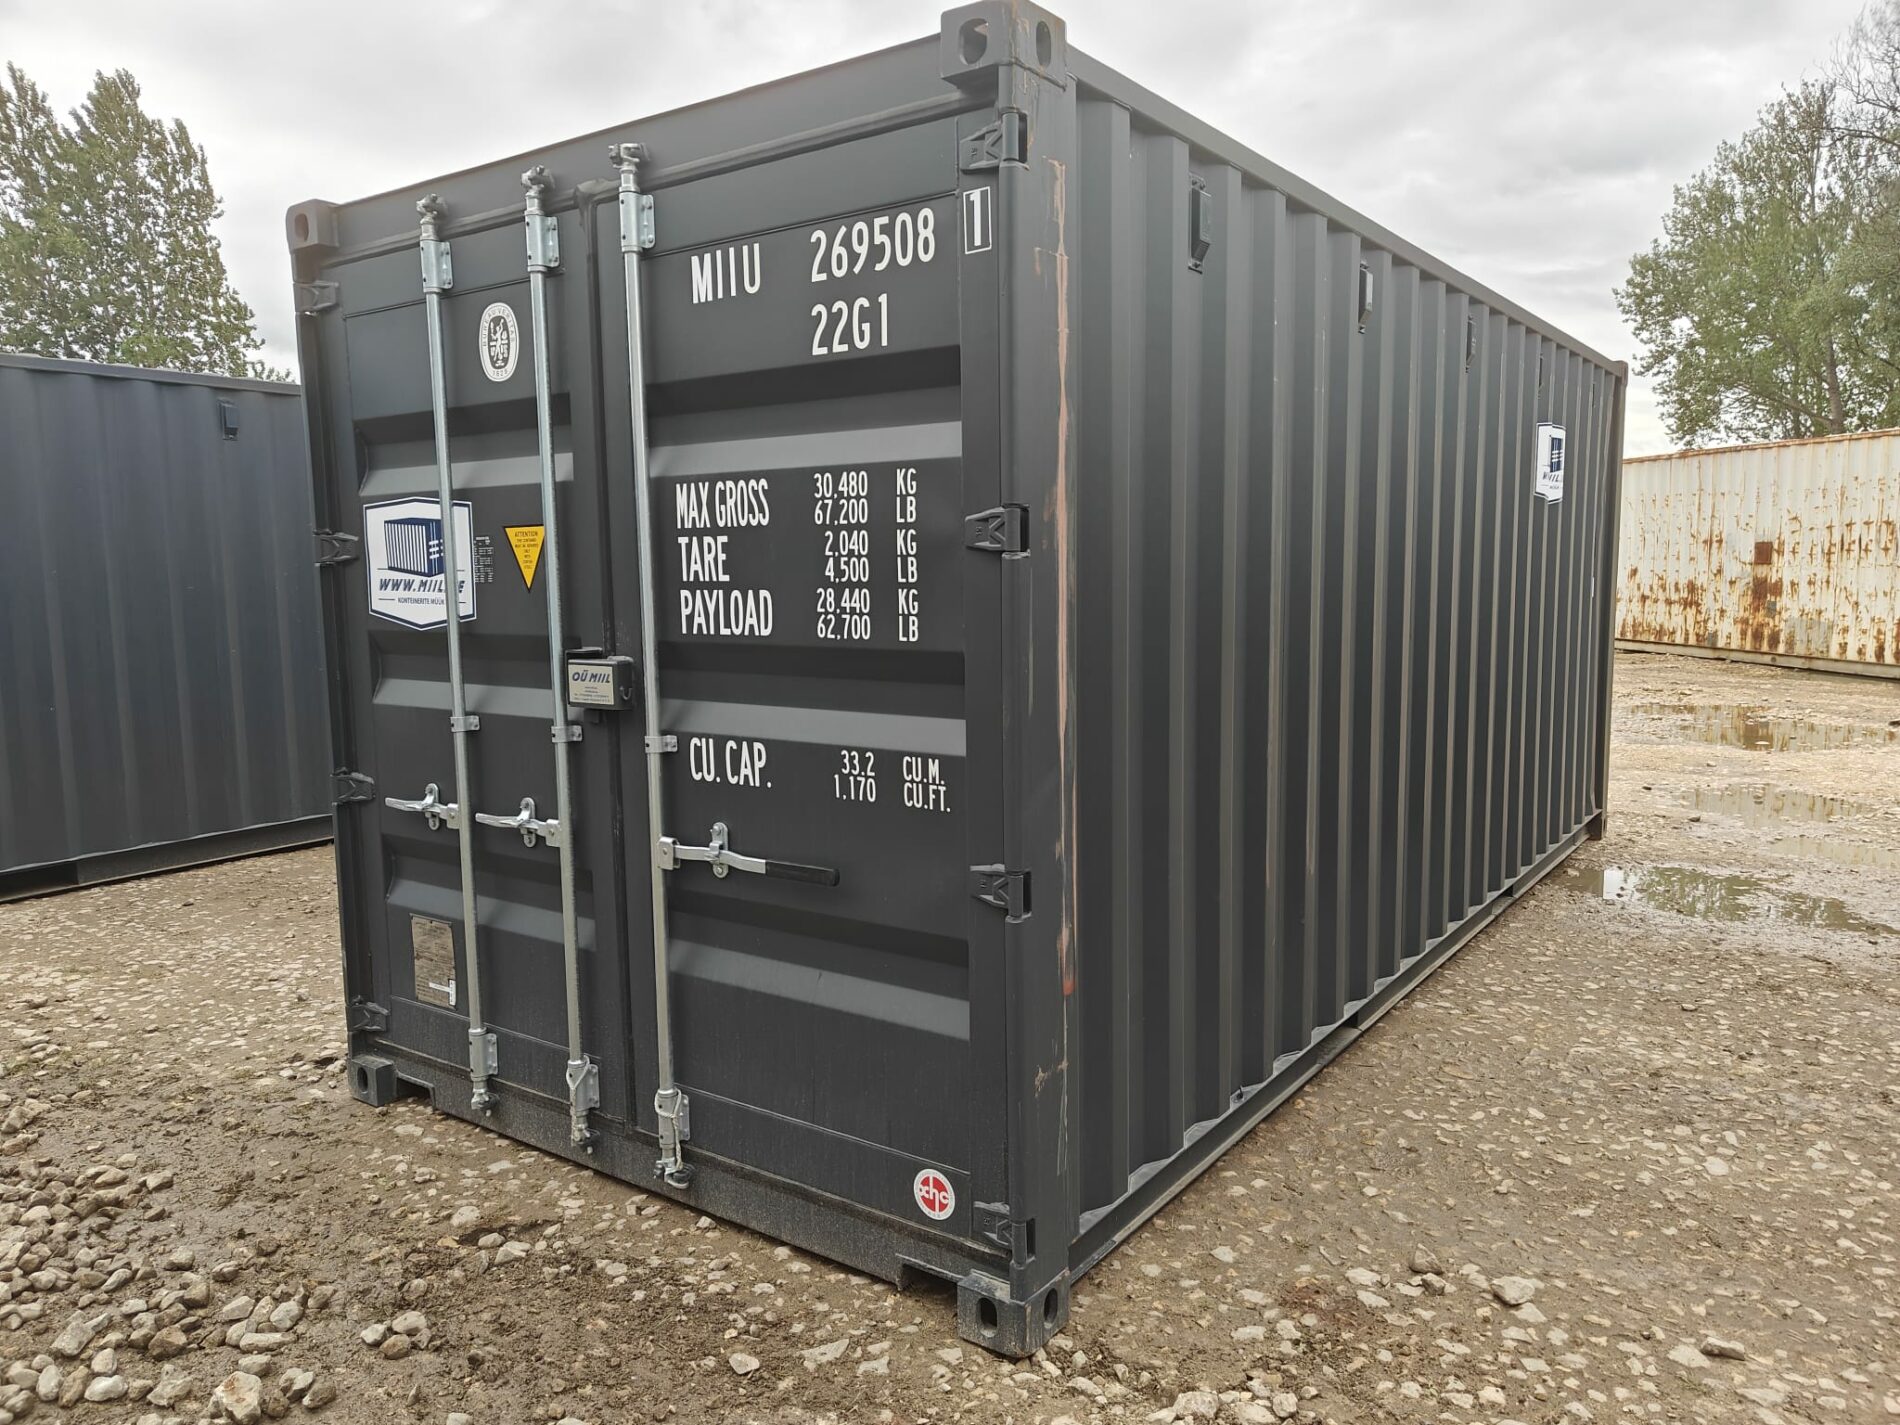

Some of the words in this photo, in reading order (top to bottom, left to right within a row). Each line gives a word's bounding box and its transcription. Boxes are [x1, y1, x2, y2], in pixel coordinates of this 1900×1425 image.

[691, 243, 760, 304] MIIU
[811, 208, 935, 282] 269508
[969, 189, 982, 247] 1
[812, 293, 888, 356] 22G1
[676, 482, 711, 529] MAX
[715, 478, 770, 527] GROSS
[813, 471, 868, 499] 30,480
[896, 468, 917, 496] KG
[814, 498, 868, 526] 67,200
[896, 496, 917, 523] LB
[678, 535, 730, 582] TARE
[824, 530, 869, 557] 2,040
[897, 529, 917, 556] KG
[824, 557, 869, 583] 4,500
[897, 557, 918, 583] LB
[680, 590, 773, 637] PAYLOAD
[816, 588, 870, 614] 28,440
[898, 589, 919, 615] KG
[817, 614, 871, 640] 62,700
[898, 616, 919, 642] LB
[572, 669, 588, 682] OÜ
[589, 673, 611, 683] MIIL
[690, 737, 721, 783] CU.
[725, 740, 772, 788] CAP.
[841, 749, 875, 777] 33.2
[902, 756, 946, 785] CU.M.
[833, 773, 876, 802] 1,170
[903, 782, 951, 812] CU.FT.
